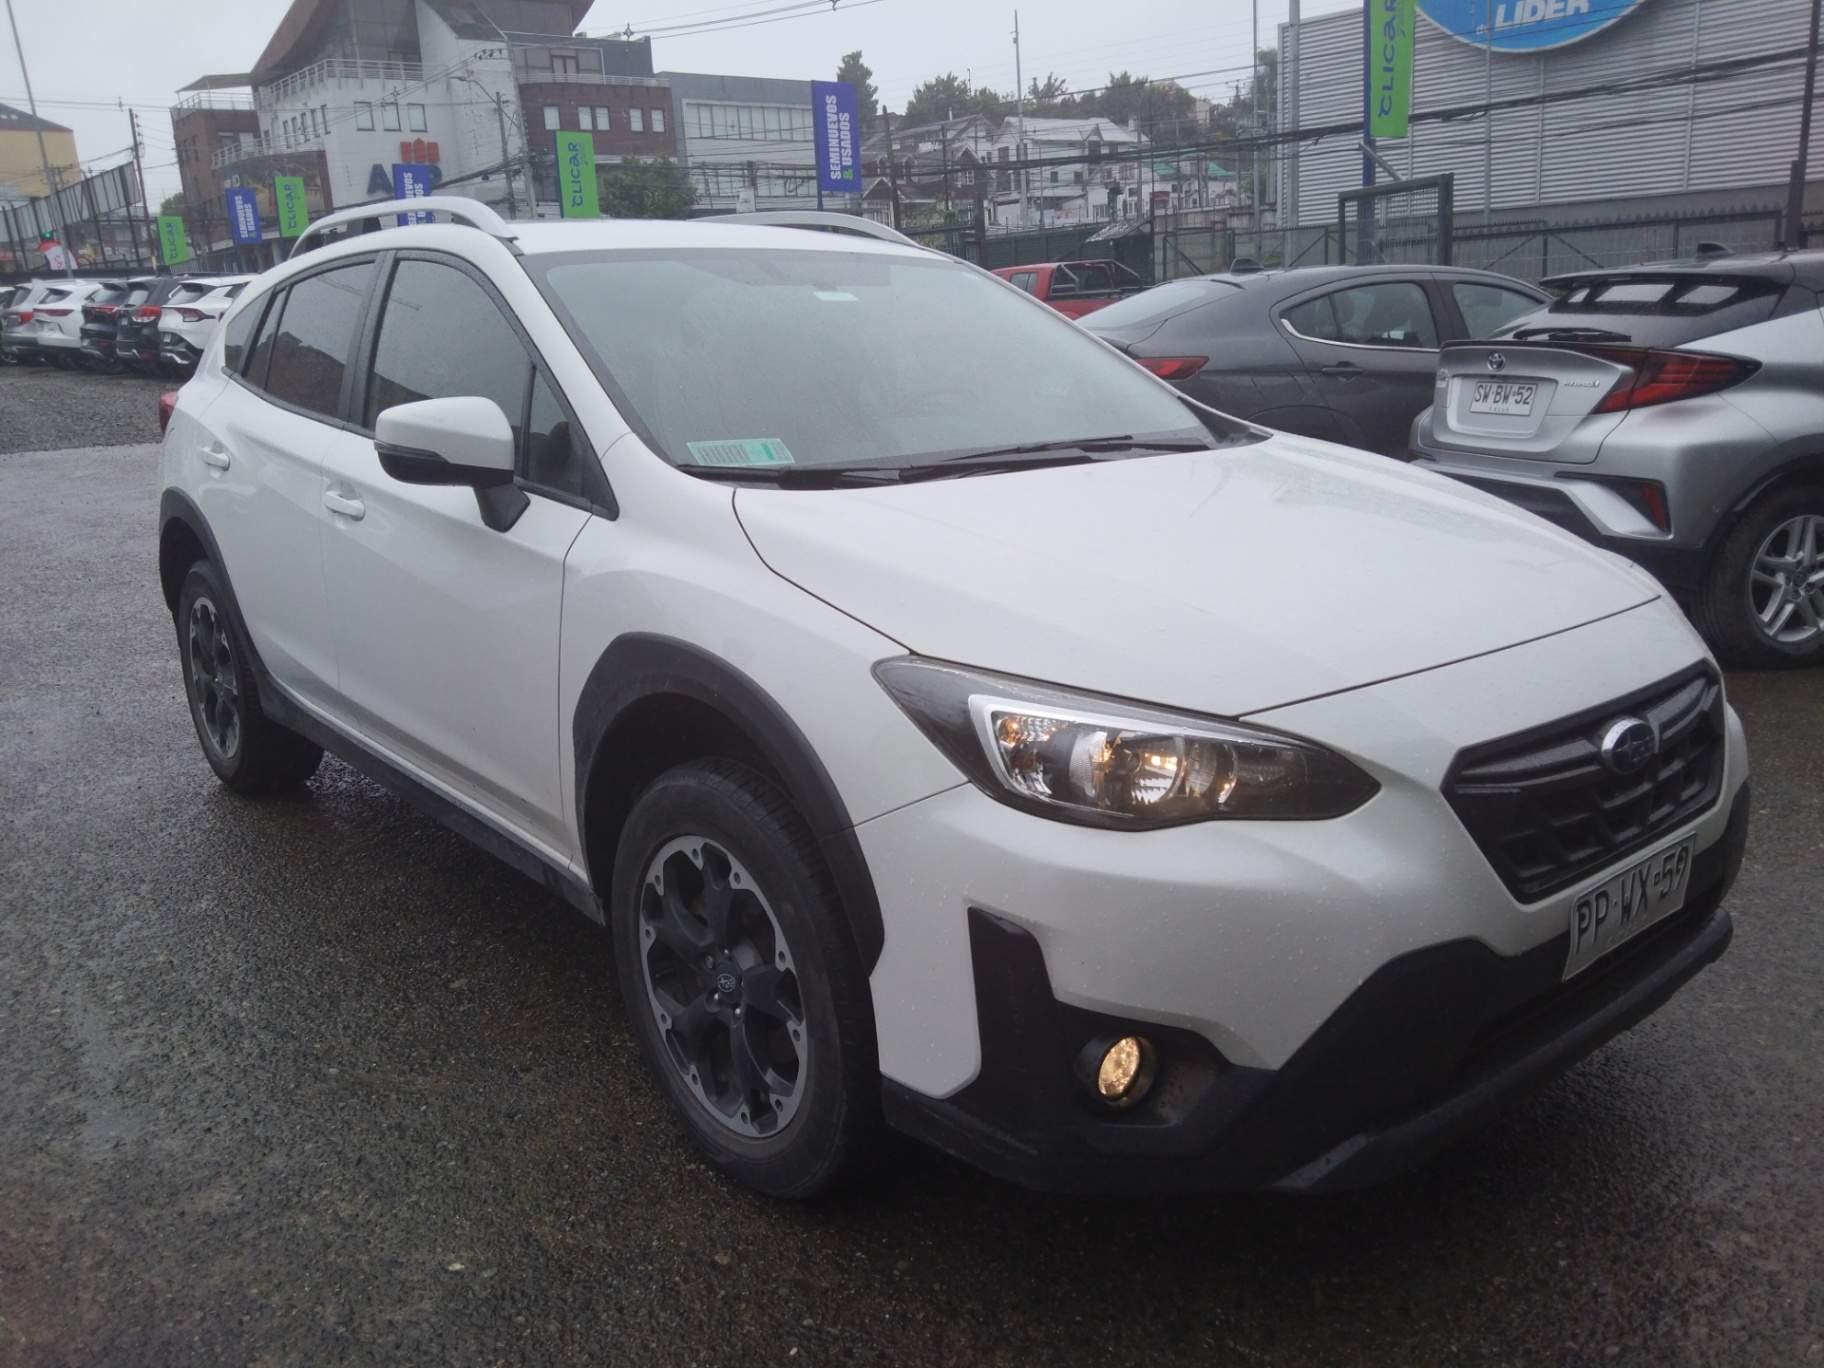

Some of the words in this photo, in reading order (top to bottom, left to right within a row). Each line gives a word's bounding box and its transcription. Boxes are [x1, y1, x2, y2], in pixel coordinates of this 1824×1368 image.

[825, 95, 841, 180] SEMINUEVOS
[839, 112, 852, 166] USADOS
[842, 167, 853, 180] &
